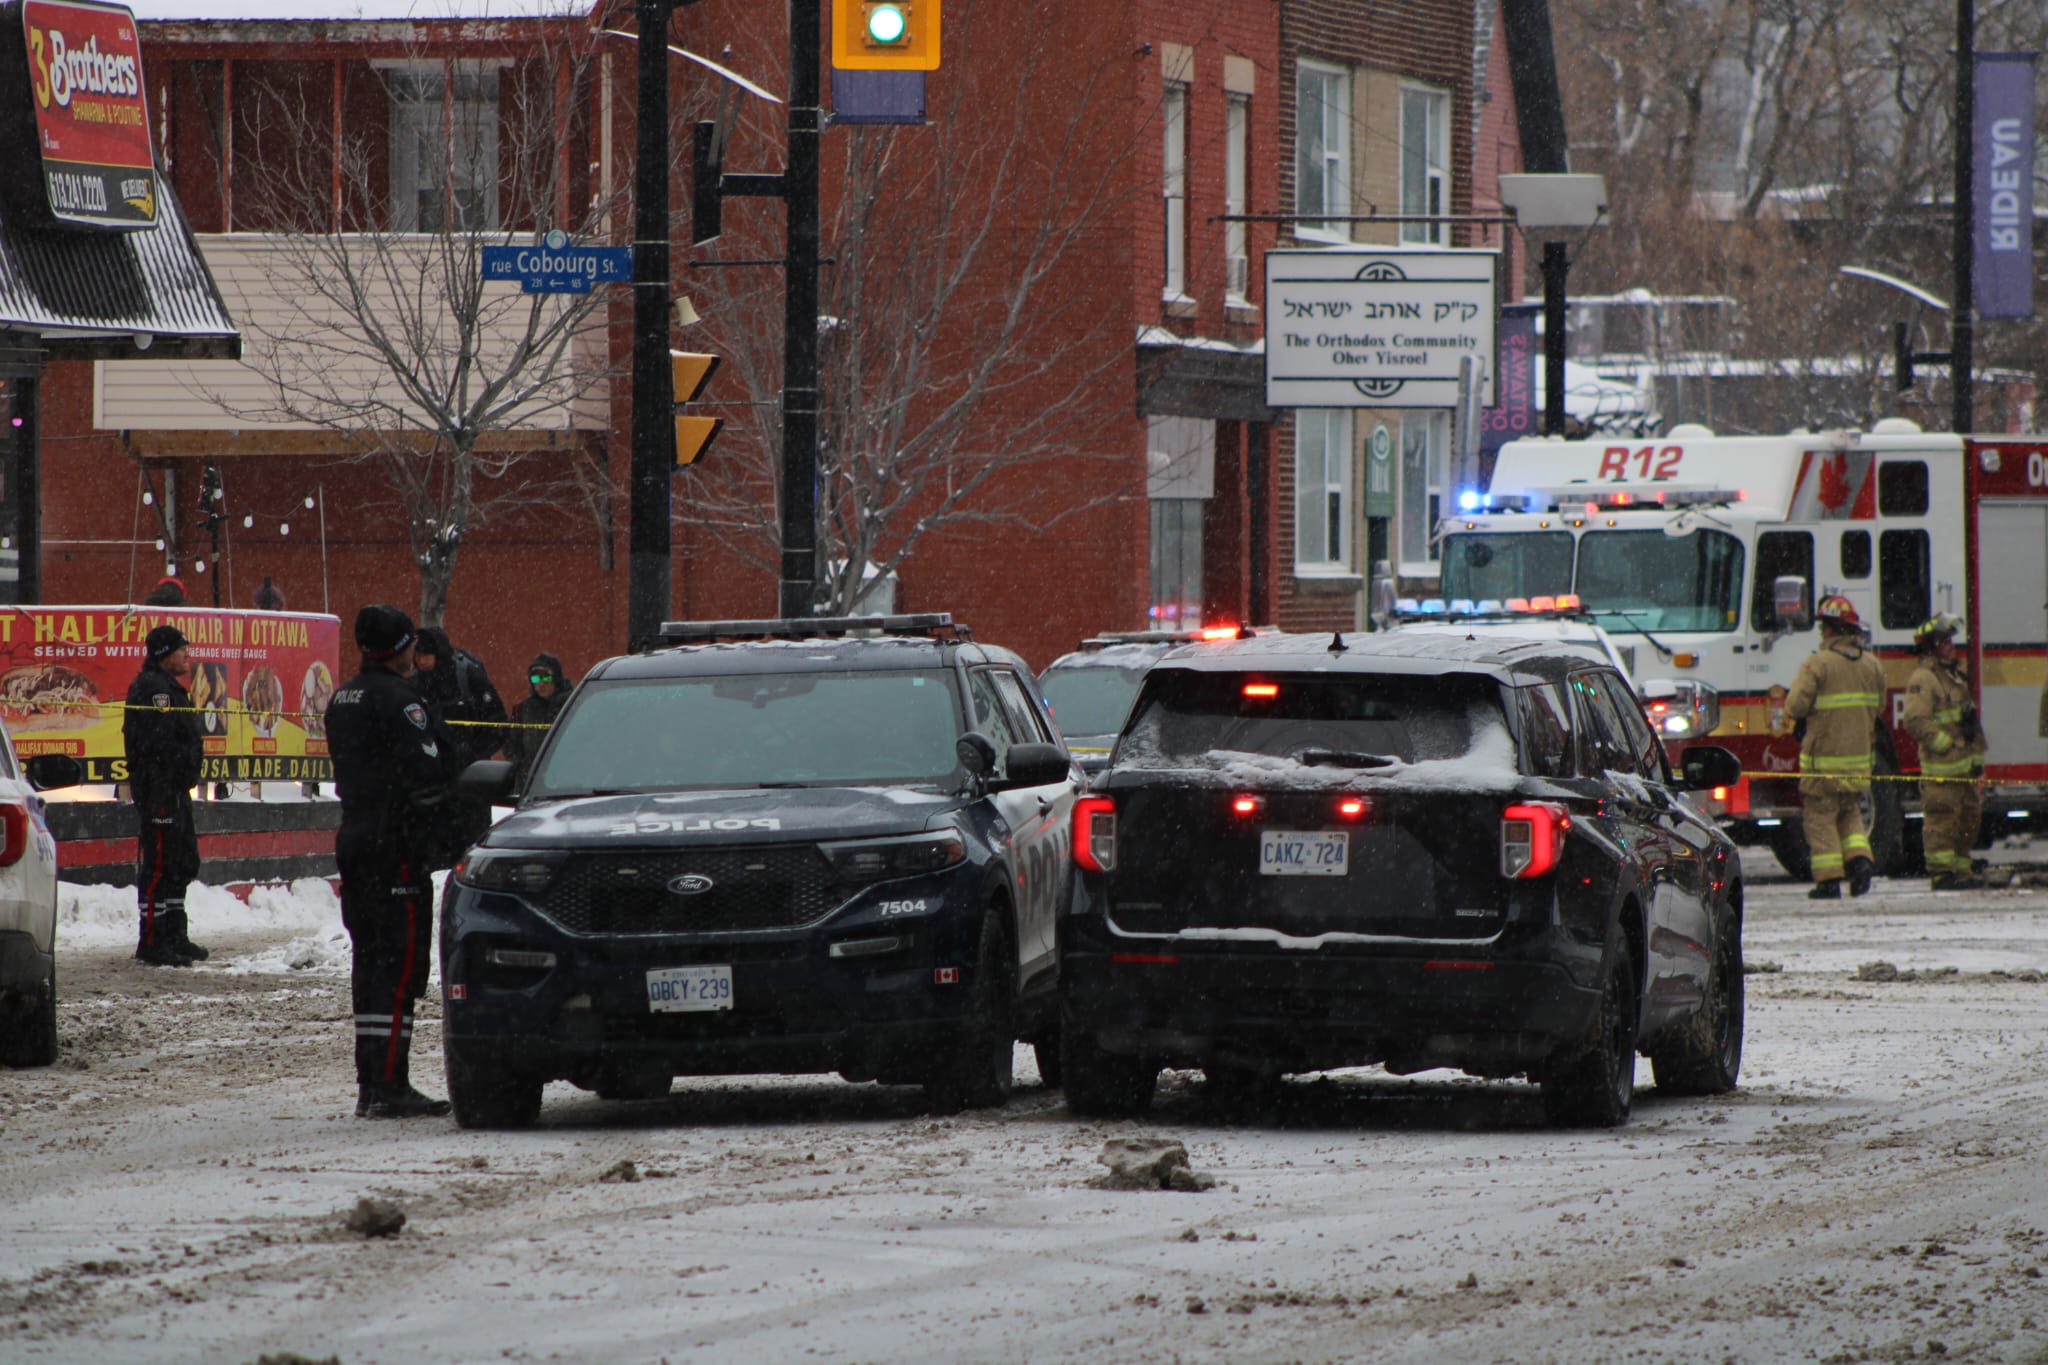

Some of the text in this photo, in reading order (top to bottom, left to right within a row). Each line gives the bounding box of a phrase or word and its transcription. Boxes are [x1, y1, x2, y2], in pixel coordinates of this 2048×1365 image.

[31, 25, 138, 108] 3 Brothers
[491, 250, 619, 280] rue Cobourg St.
[1283, 298, 1352, 319] ישראל
[1364, 301, 1421, 319] אוהב
[1284, 333, 1478, 350] The Orthodox Community
[1332, 351, 1427, 365] Ohev Yisroel
[1598, 446, 1684, 479] R12
[229, 618, 244, 645] IN
[251, 620, 309, 648] OTTAWA
[34, 646, 97, 657] SERVED
[244, 649, 267, 659] SAUCE
[334, 690, 365, 704] POLICE
[238, 758, 281, 778] MADE
[1264, 842, 1344, 864] CAKZ 724
[879, 899, 927, 916] 7504
[700, 978, 729, 1000] 239
